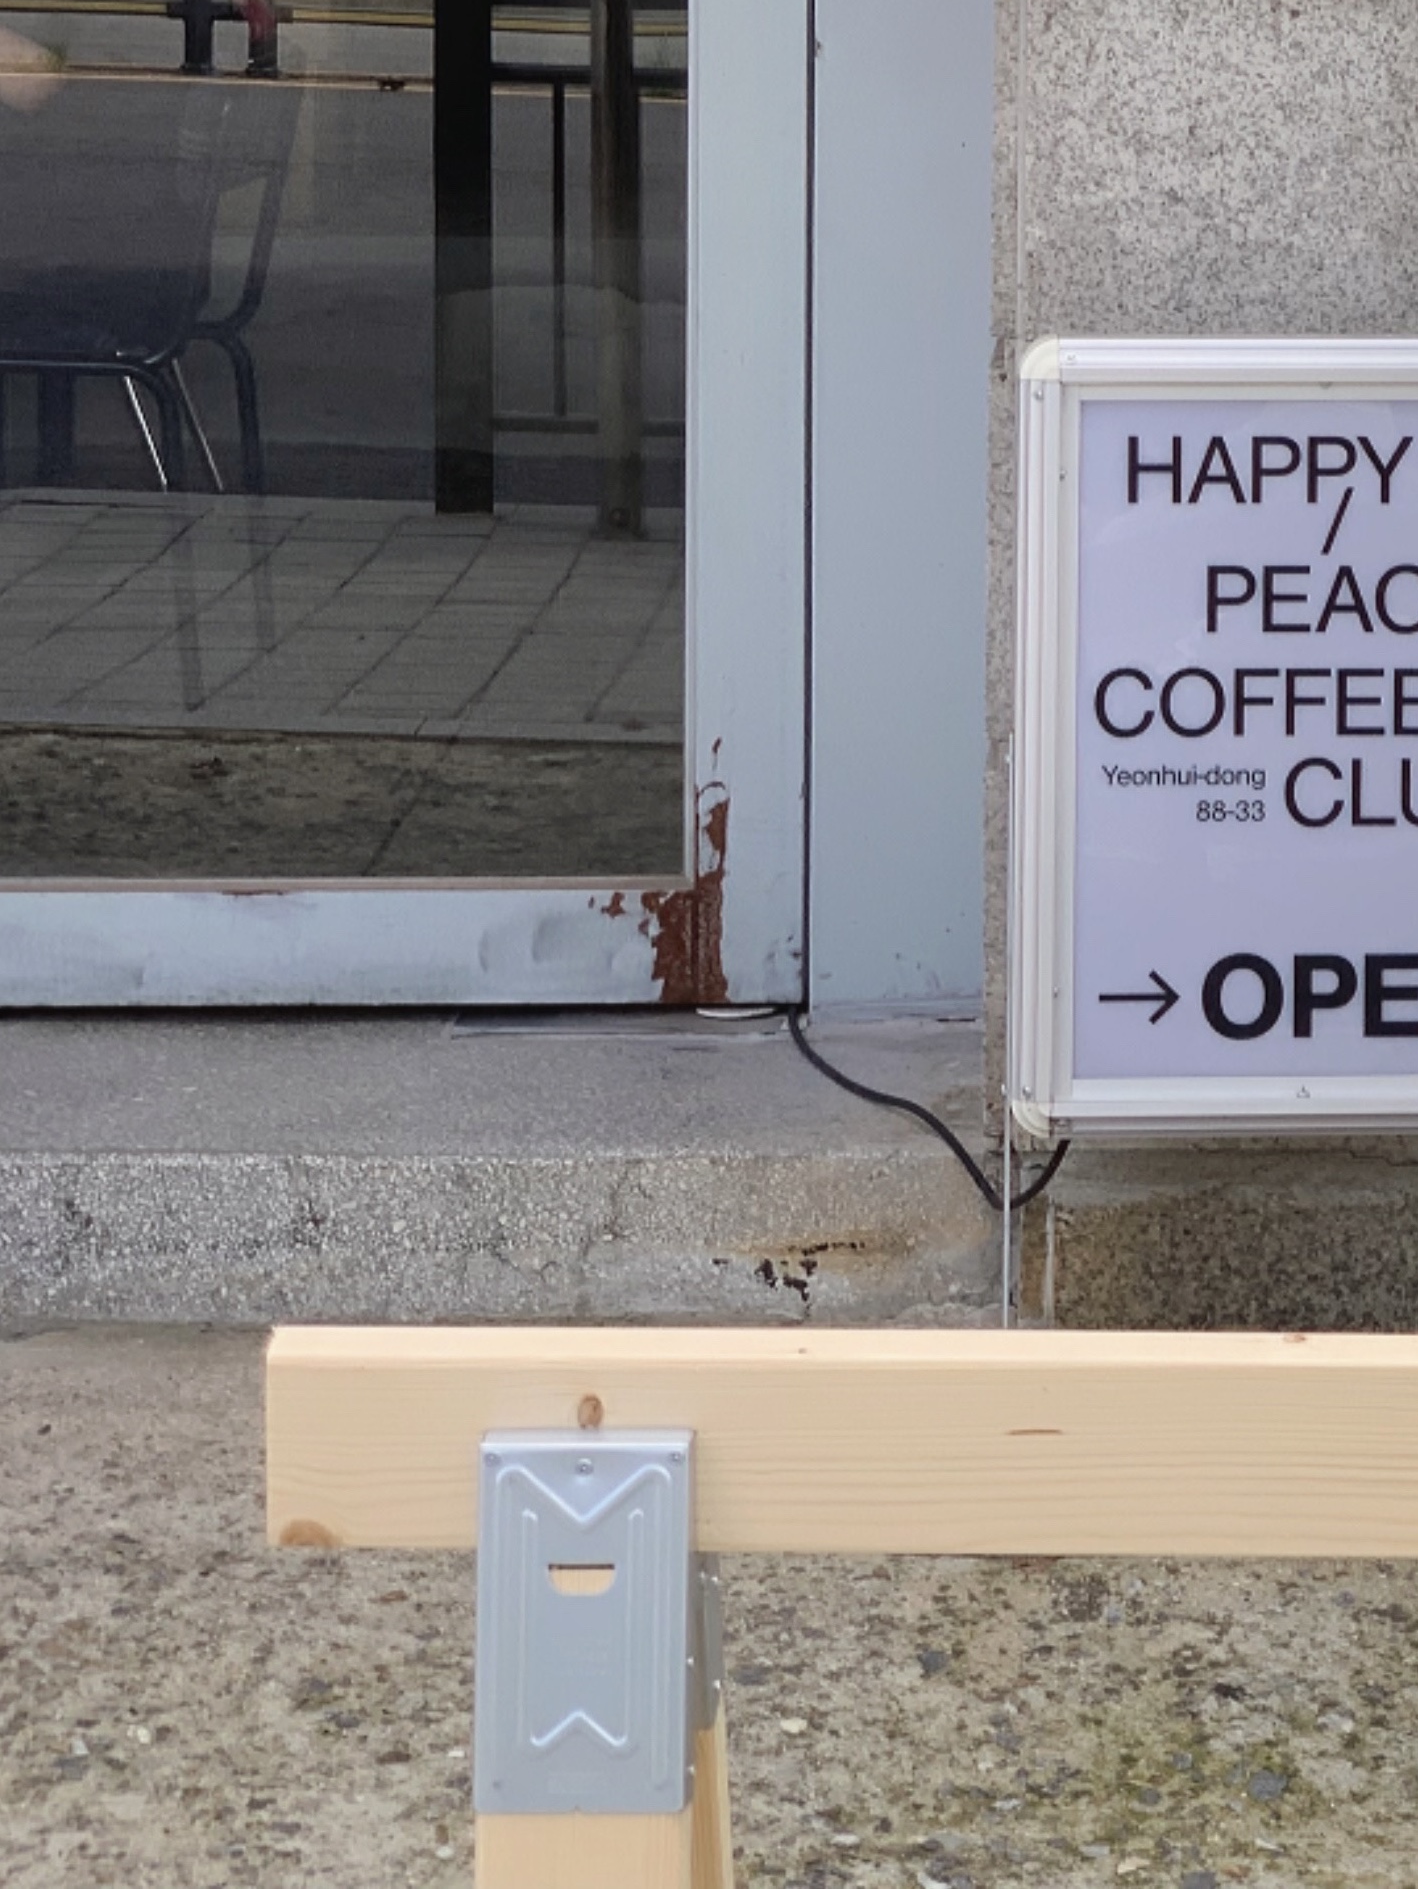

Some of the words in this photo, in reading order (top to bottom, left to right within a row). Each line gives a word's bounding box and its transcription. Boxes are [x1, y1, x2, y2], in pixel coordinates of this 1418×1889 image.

[1125, 435, 1415, 505] HAPPY
[1101, 764, 1267, 791] Yeonhui-dong
[1196, 799, 1266, 823] 88-33
